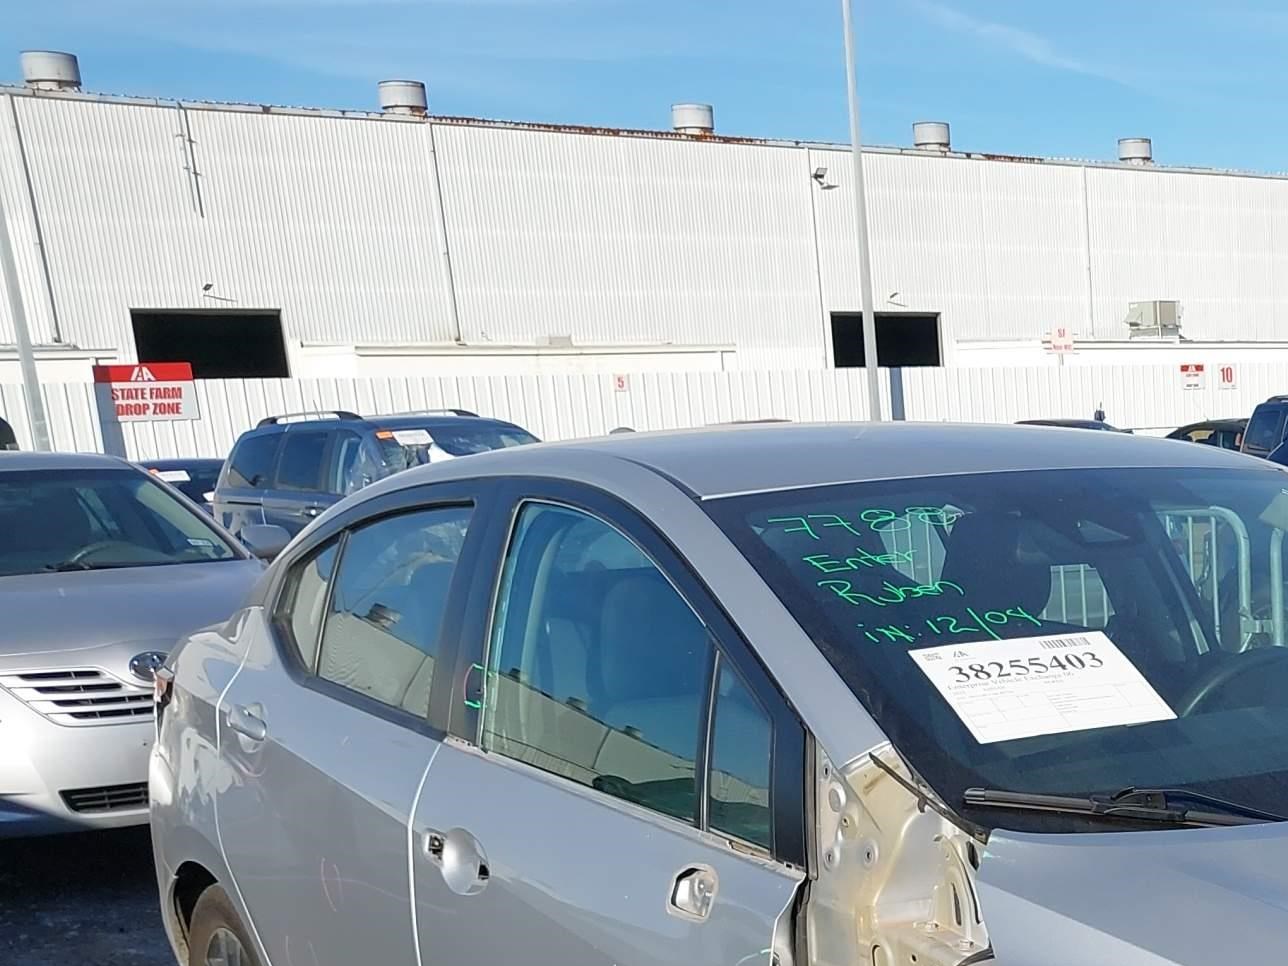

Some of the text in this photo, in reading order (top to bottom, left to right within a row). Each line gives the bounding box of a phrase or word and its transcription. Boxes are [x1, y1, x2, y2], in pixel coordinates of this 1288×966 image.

[1220, 366, 1234, 384] 10
[617, 376, 625, 389] 5
[112, 387, 183, 400] STATE FARM
[116, 402, 183, 416] DROP ZONE
[949, 651, 1104, 683] 38255403
